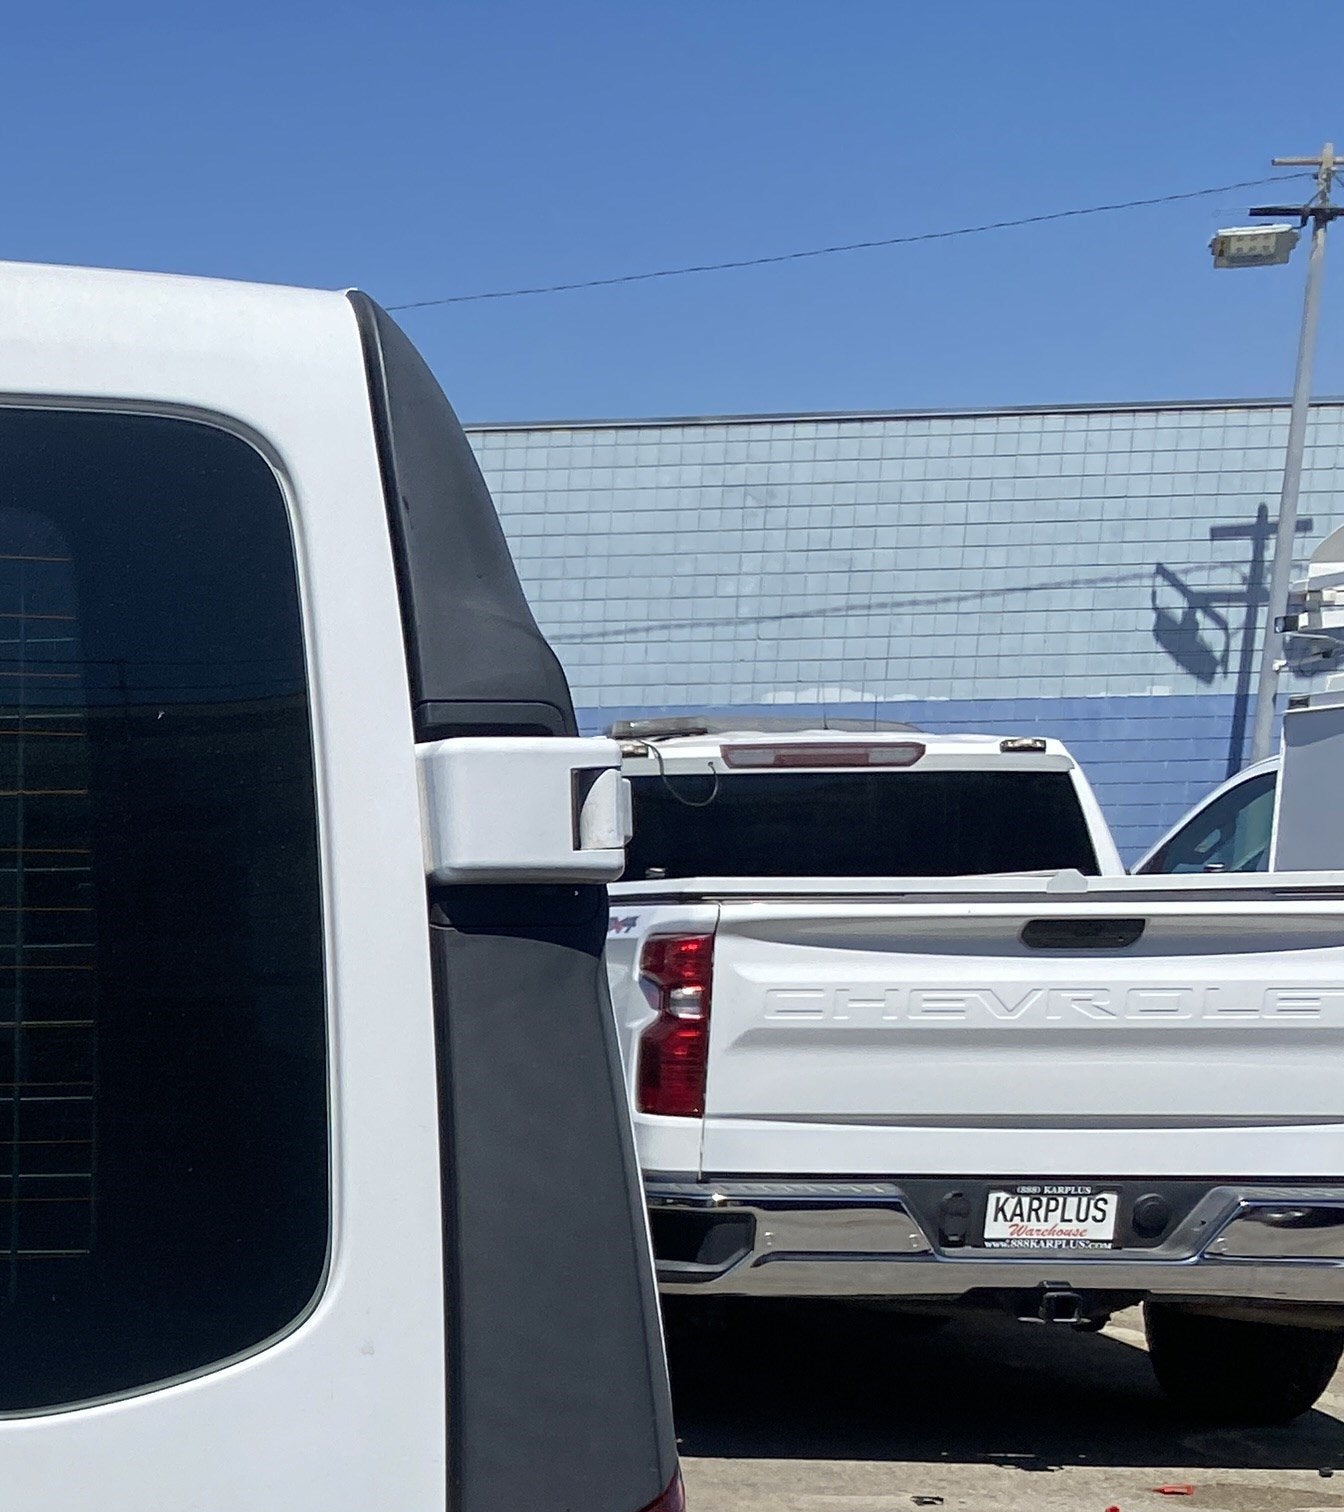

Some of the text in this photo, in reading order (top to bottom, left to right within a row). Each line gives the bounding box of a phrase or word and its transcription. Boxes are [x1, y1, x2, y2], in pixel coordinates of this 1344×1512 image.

[762, 986, 1344, 1020] CHEVROLE
[1016, 1186, 1092, 1195] (888) KARPLUS
[993, 1196, 1109, 1223] KARPLUS
[1008, 1223, 1088, 1237] Warehouse
